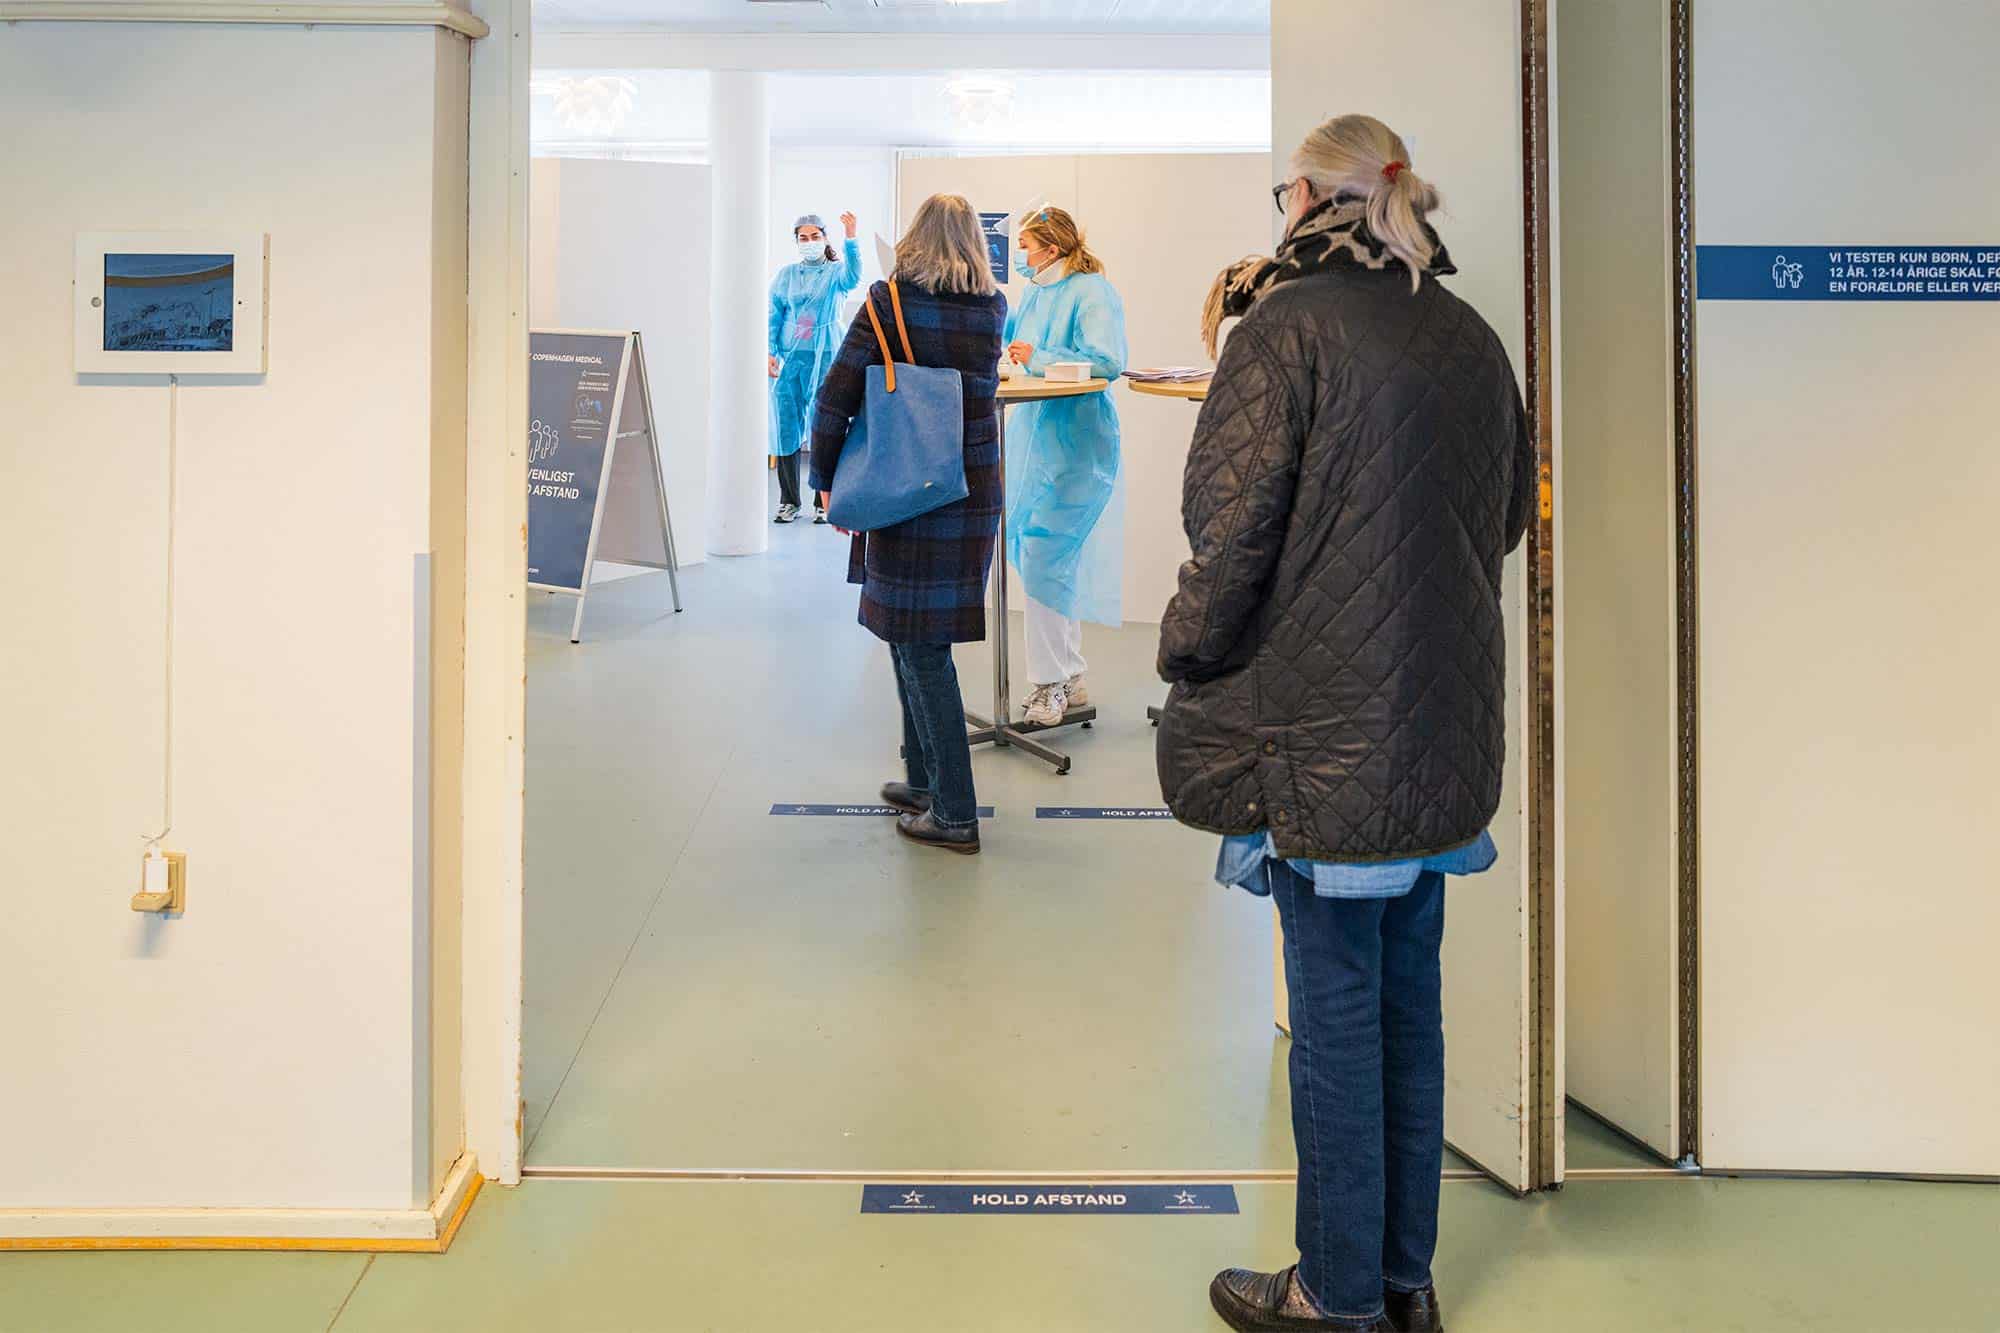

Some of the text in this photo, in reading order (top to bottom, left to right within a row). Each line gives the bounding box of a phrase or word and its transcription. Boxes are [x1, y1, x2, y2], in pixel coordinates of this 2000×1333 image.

[1829, 252, 1841, 263] VI
[1845, 252, 1895, 263] TESTER
[1899, 252, 1927, 263] KUN
[1931, 252, 1973, 265] BØRN,
[1829, 267, 1843, 278] 12
[1846, 264, 1868, 278] ÅR.
[1871, 267, 1904, 278] 12-14
[1906, 264, 1947, 278] ÅRIGE
[1950, 267, 1984, 278] SKAL
[1829, 282, 1847, 293] EN
[1850, 282, 1924, 293] FORÆLDRE
[1927, 282, 1969, 293] ELLER
[532, 352, 574, 362] COPENHAGEN
[575, 354, 603, 365] MEDICAL
[532, 484, 580, 500] AFSTAND
[972, 1194, 1127, 1206] HOLD AFSTAND
